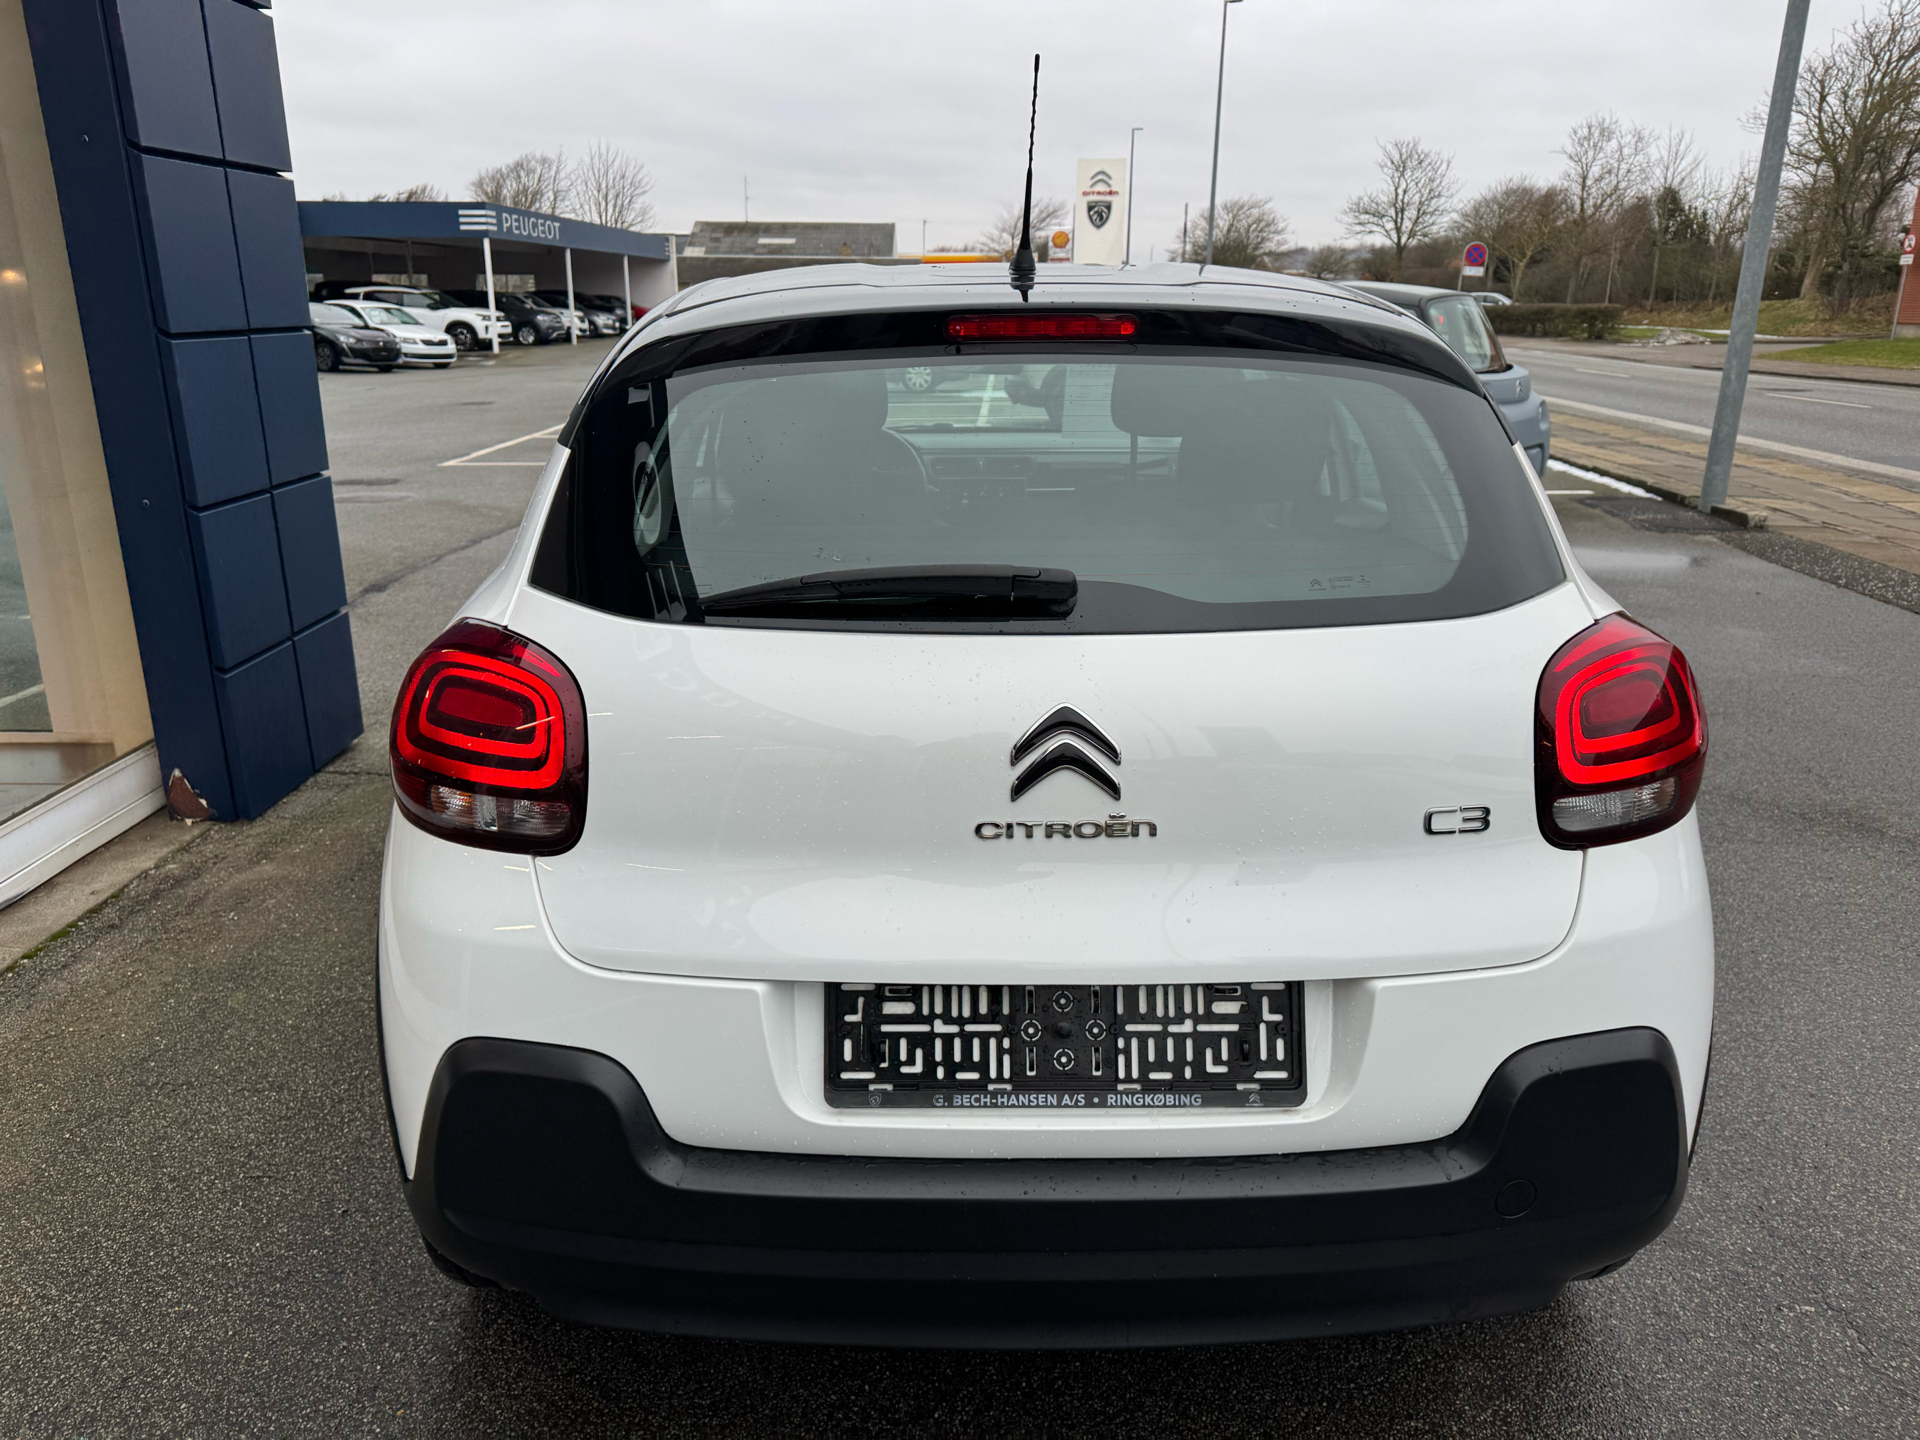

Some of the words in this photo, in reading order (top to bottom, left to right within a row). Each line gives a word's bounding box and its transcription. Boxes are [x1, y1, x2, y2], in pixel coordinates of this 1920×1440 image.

[502, 212, 561, 240] PEUGEOT
[974, 812, 1158, 839] CITROËN
[1423, 804, 1491, 835] C3
[932, 1094, 948, 1107] G.
[952, 1094, 1057, 1107] BECH-HANSEN
[1061, 1094, 1086, 1107] A/S
[1107, 1093, 1202, 1107] RINGKØBING
